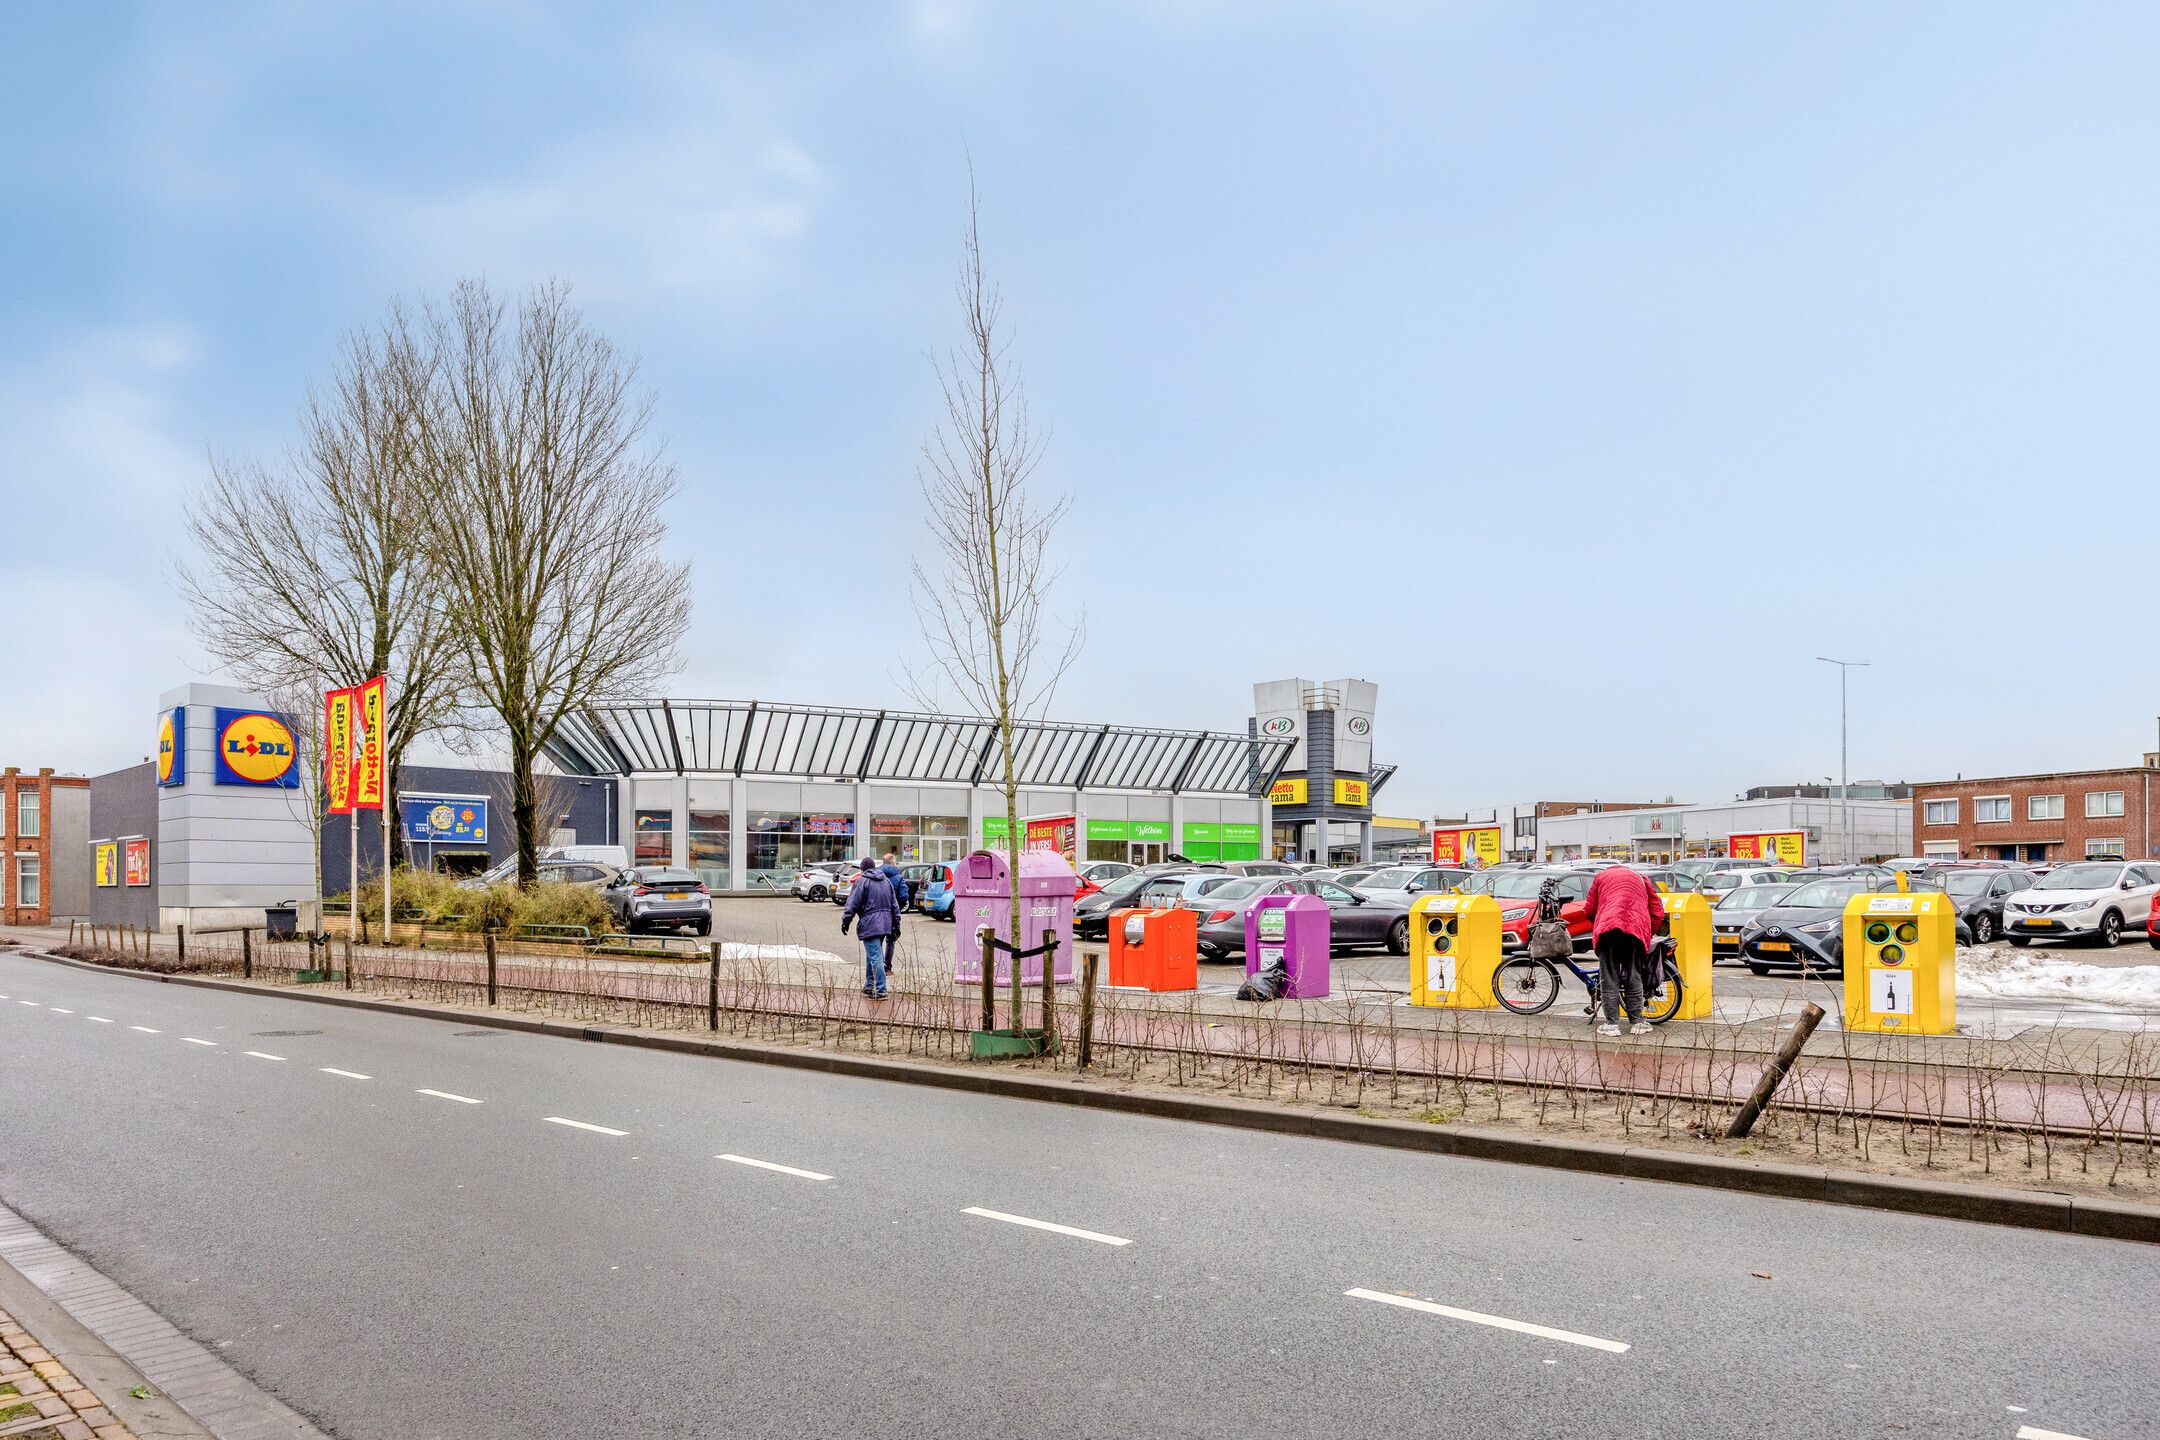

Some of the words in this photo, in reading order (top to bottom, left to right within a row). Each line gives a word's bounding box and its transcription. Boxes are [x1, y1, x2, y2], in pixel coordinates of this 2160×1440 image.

[160, 739, 171, 753] DL
[1270, 783, 1294, 794] Netto
[1345, 782, 1361, 794] Netto
[1270, 793, 1294, 803] rama
[1345, 793, 1361, 803] rama
[1037, 826, 1053, 838] BESTE
[1135, 825, 1163, 836] Welkom
[1438, 845, 1455, 858] 10%
[1735, 848, 1754, 858] 10%
